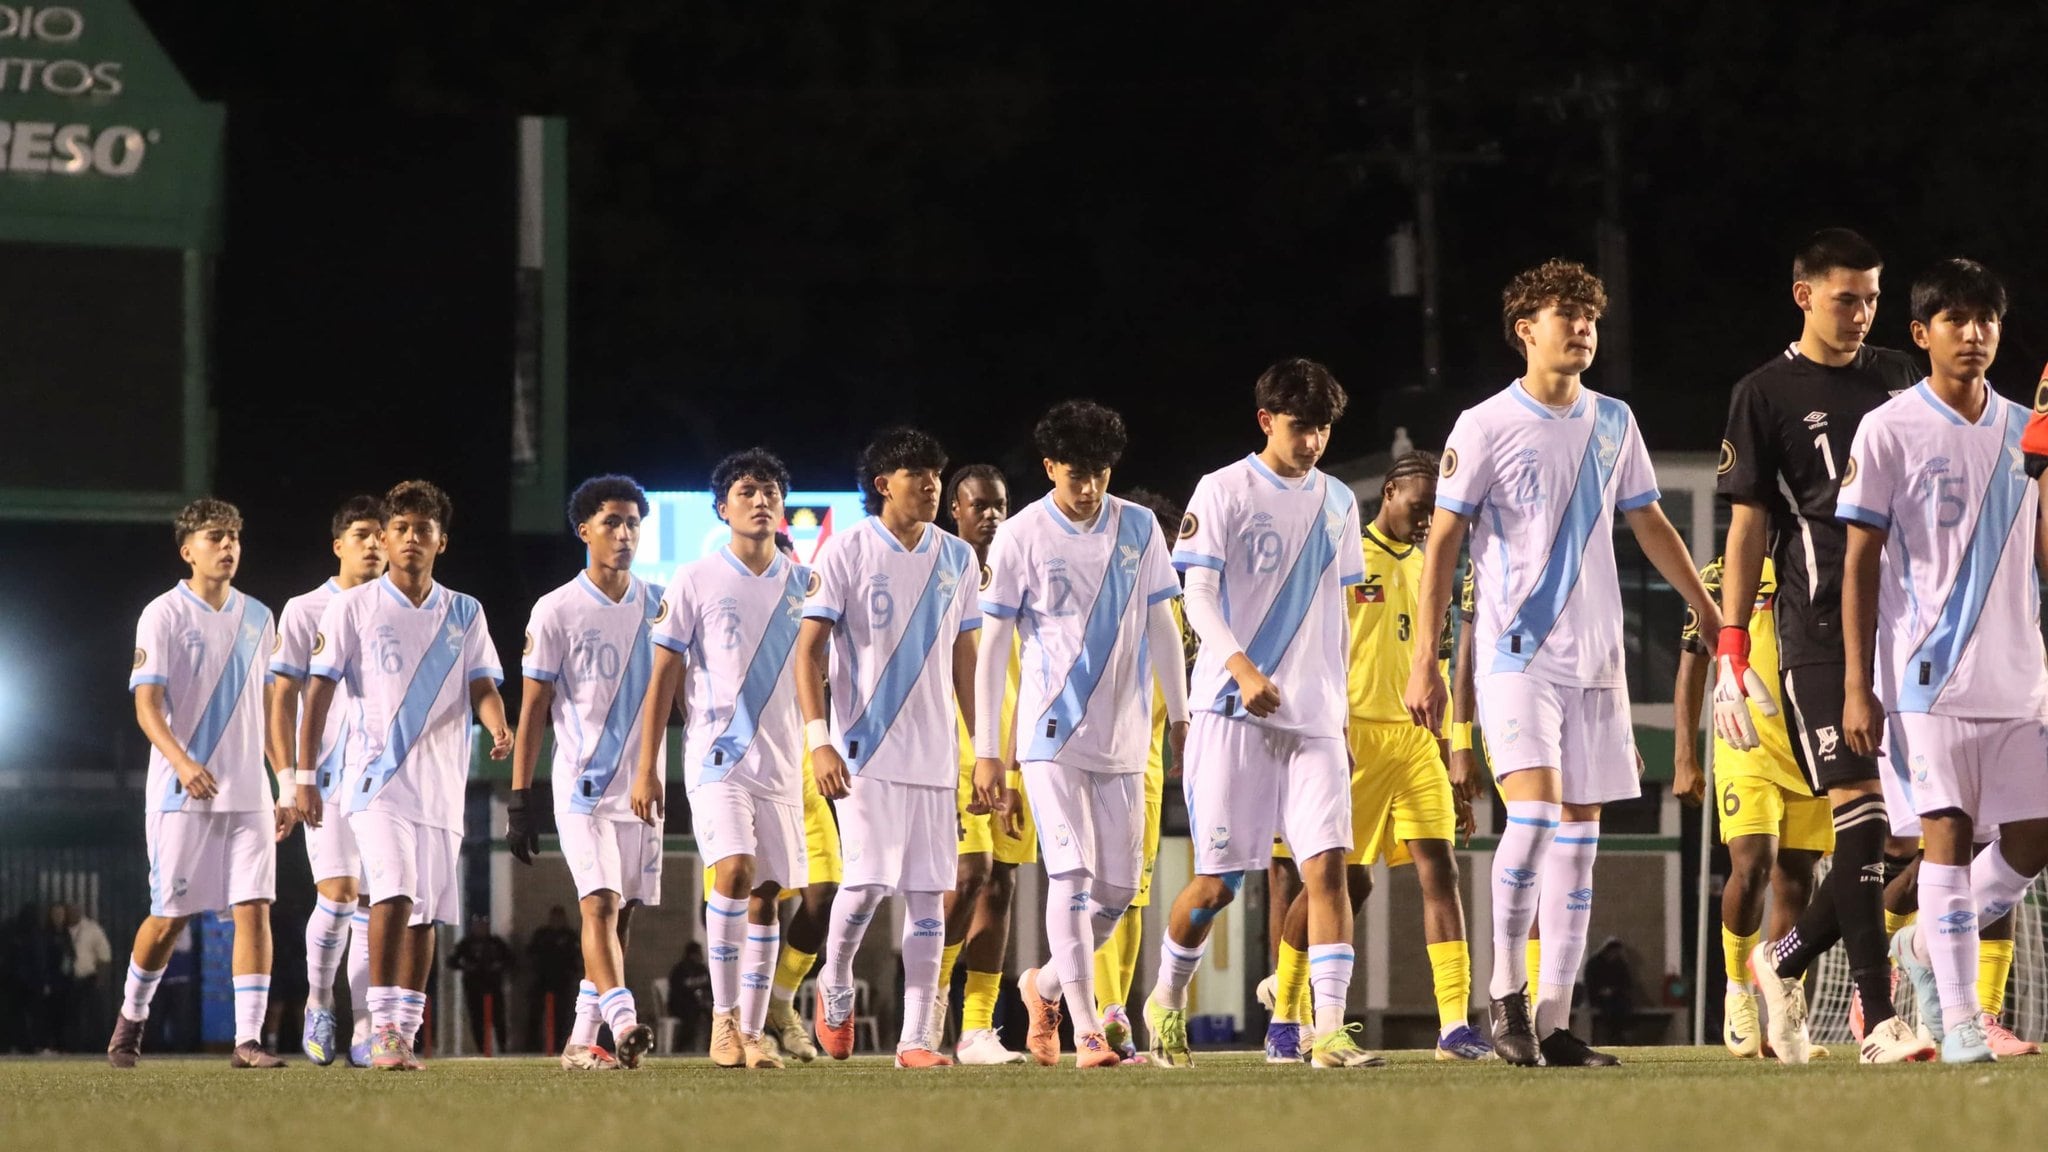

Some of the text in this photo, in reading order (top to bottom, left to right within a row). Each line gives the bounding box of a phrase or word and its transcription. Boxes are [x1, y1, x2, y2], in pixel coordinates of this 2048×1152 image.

[0, 120, 146, 176] ESO
[1814, 433, 1837, 480] 1
[1241, 531, 1283, 574] 19
[871, 590, 894, 629] 9
[1048, 575, 1076, 617] 2
[1398, 613, 1411, 642] 3
[1723, 782, 1741, 817] 6
[1566, 902, 1592, 911] umb
